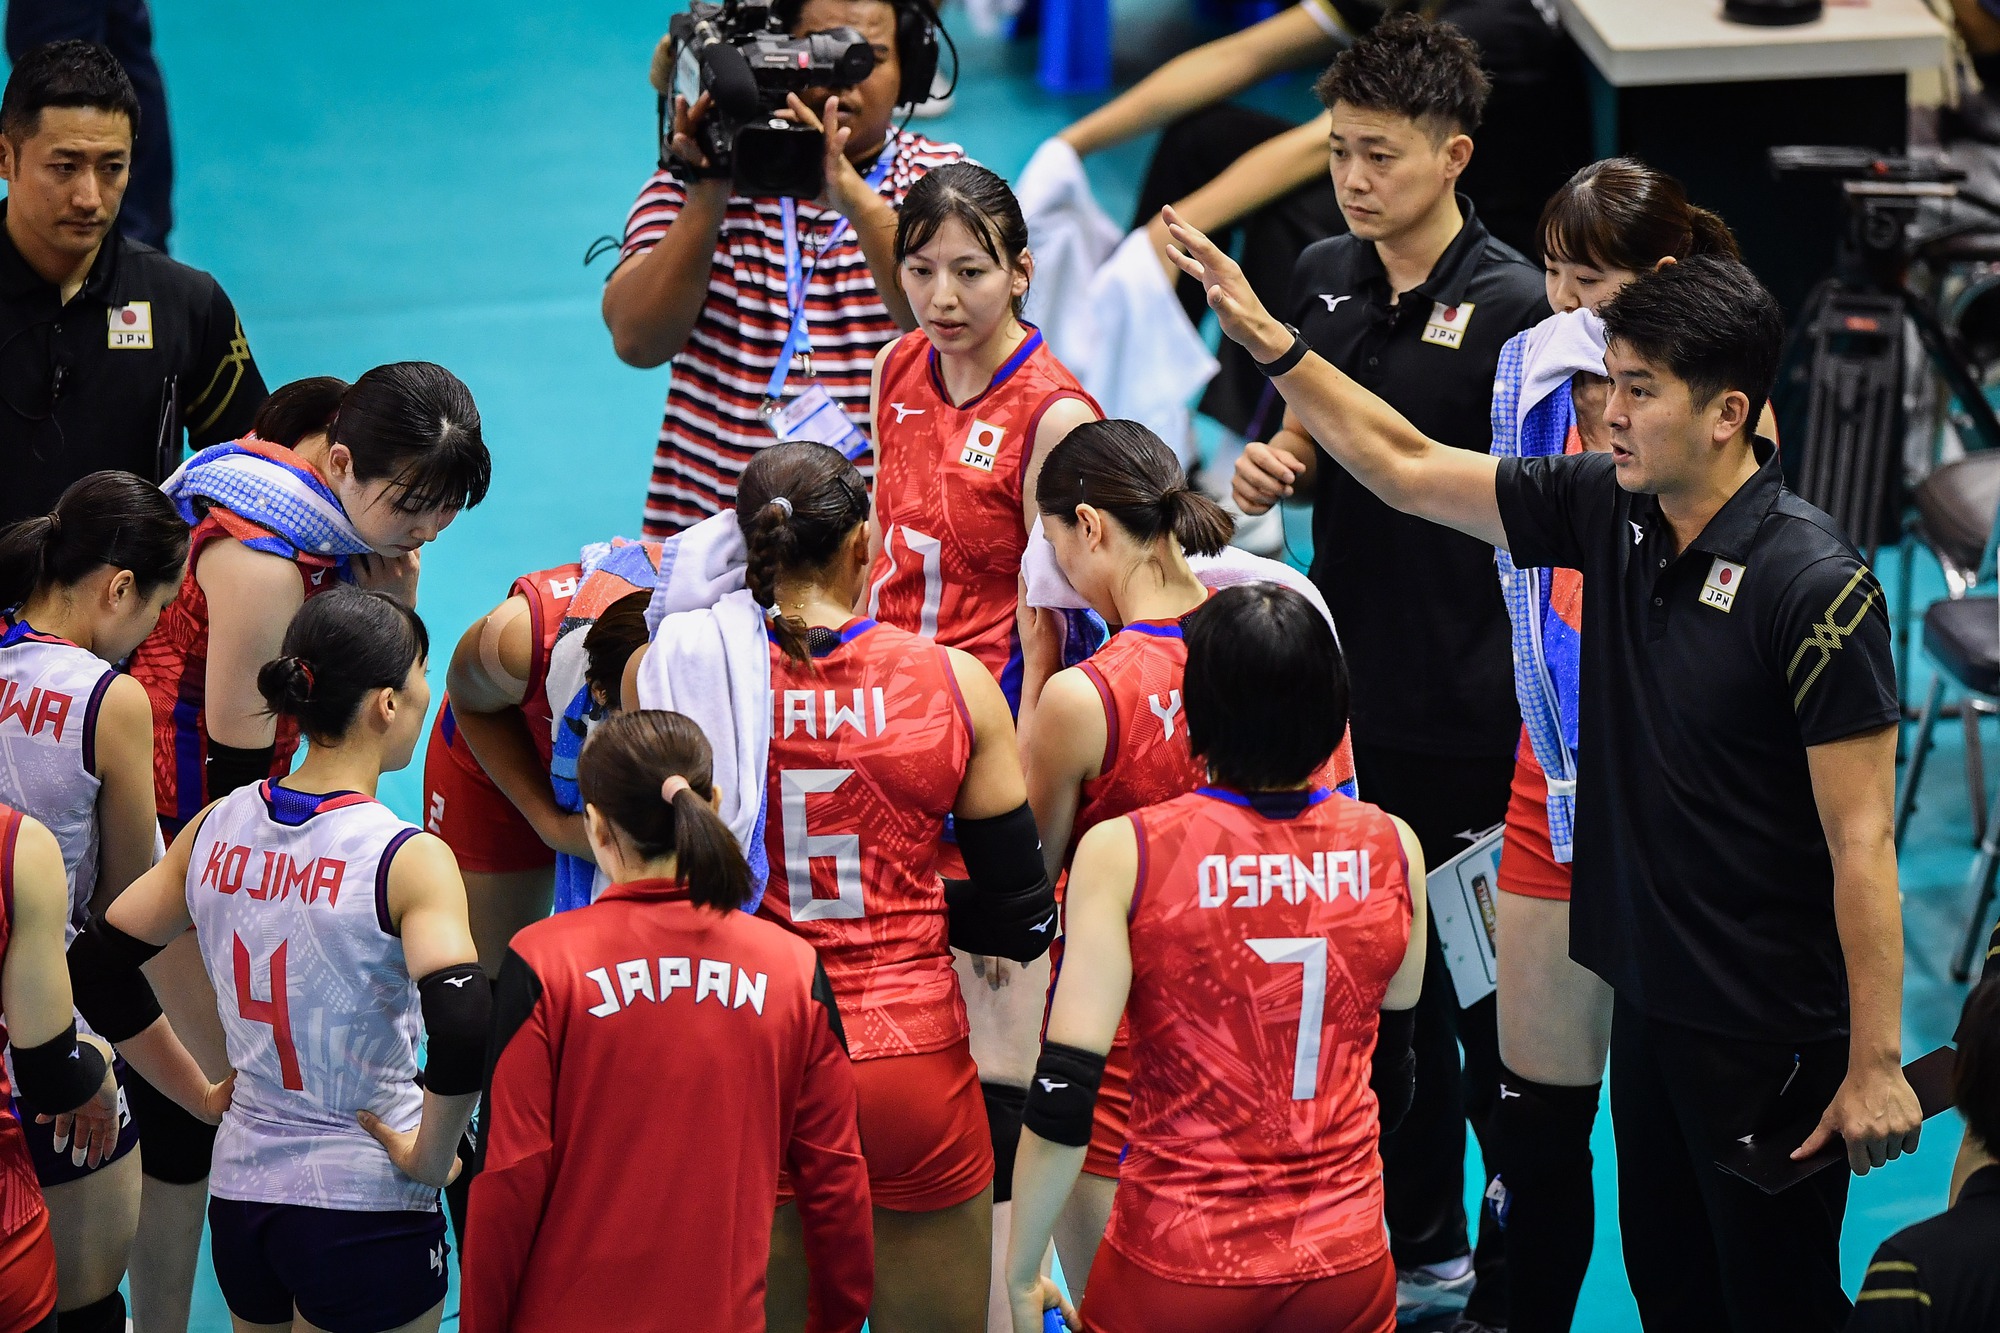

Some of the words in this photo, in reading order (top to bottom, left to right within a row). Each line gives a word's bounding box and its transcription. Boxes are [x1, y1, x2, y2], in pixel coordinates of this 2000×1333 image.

[116, 334, 145, 344] JPN
[1430, 329, 1456, 342] JPN
[965, 451, 991, 467] JPN
[1706, 590, 1729, 607] JPN
[0, 676, 73, 744] WA
[770, 687, 886, 740] AWI
[781, 769, 865, 922] 6
[200, 841, 347, 909] KOJIMA
[1199, 850, 1369, 908] OSANAI
[233, 929, 304, 1091] 4
[585, 957, 768, 1018] JAPAN
[1244, 937, 1327, 1100] 7
[429, 1239, 443, 1277] 4
